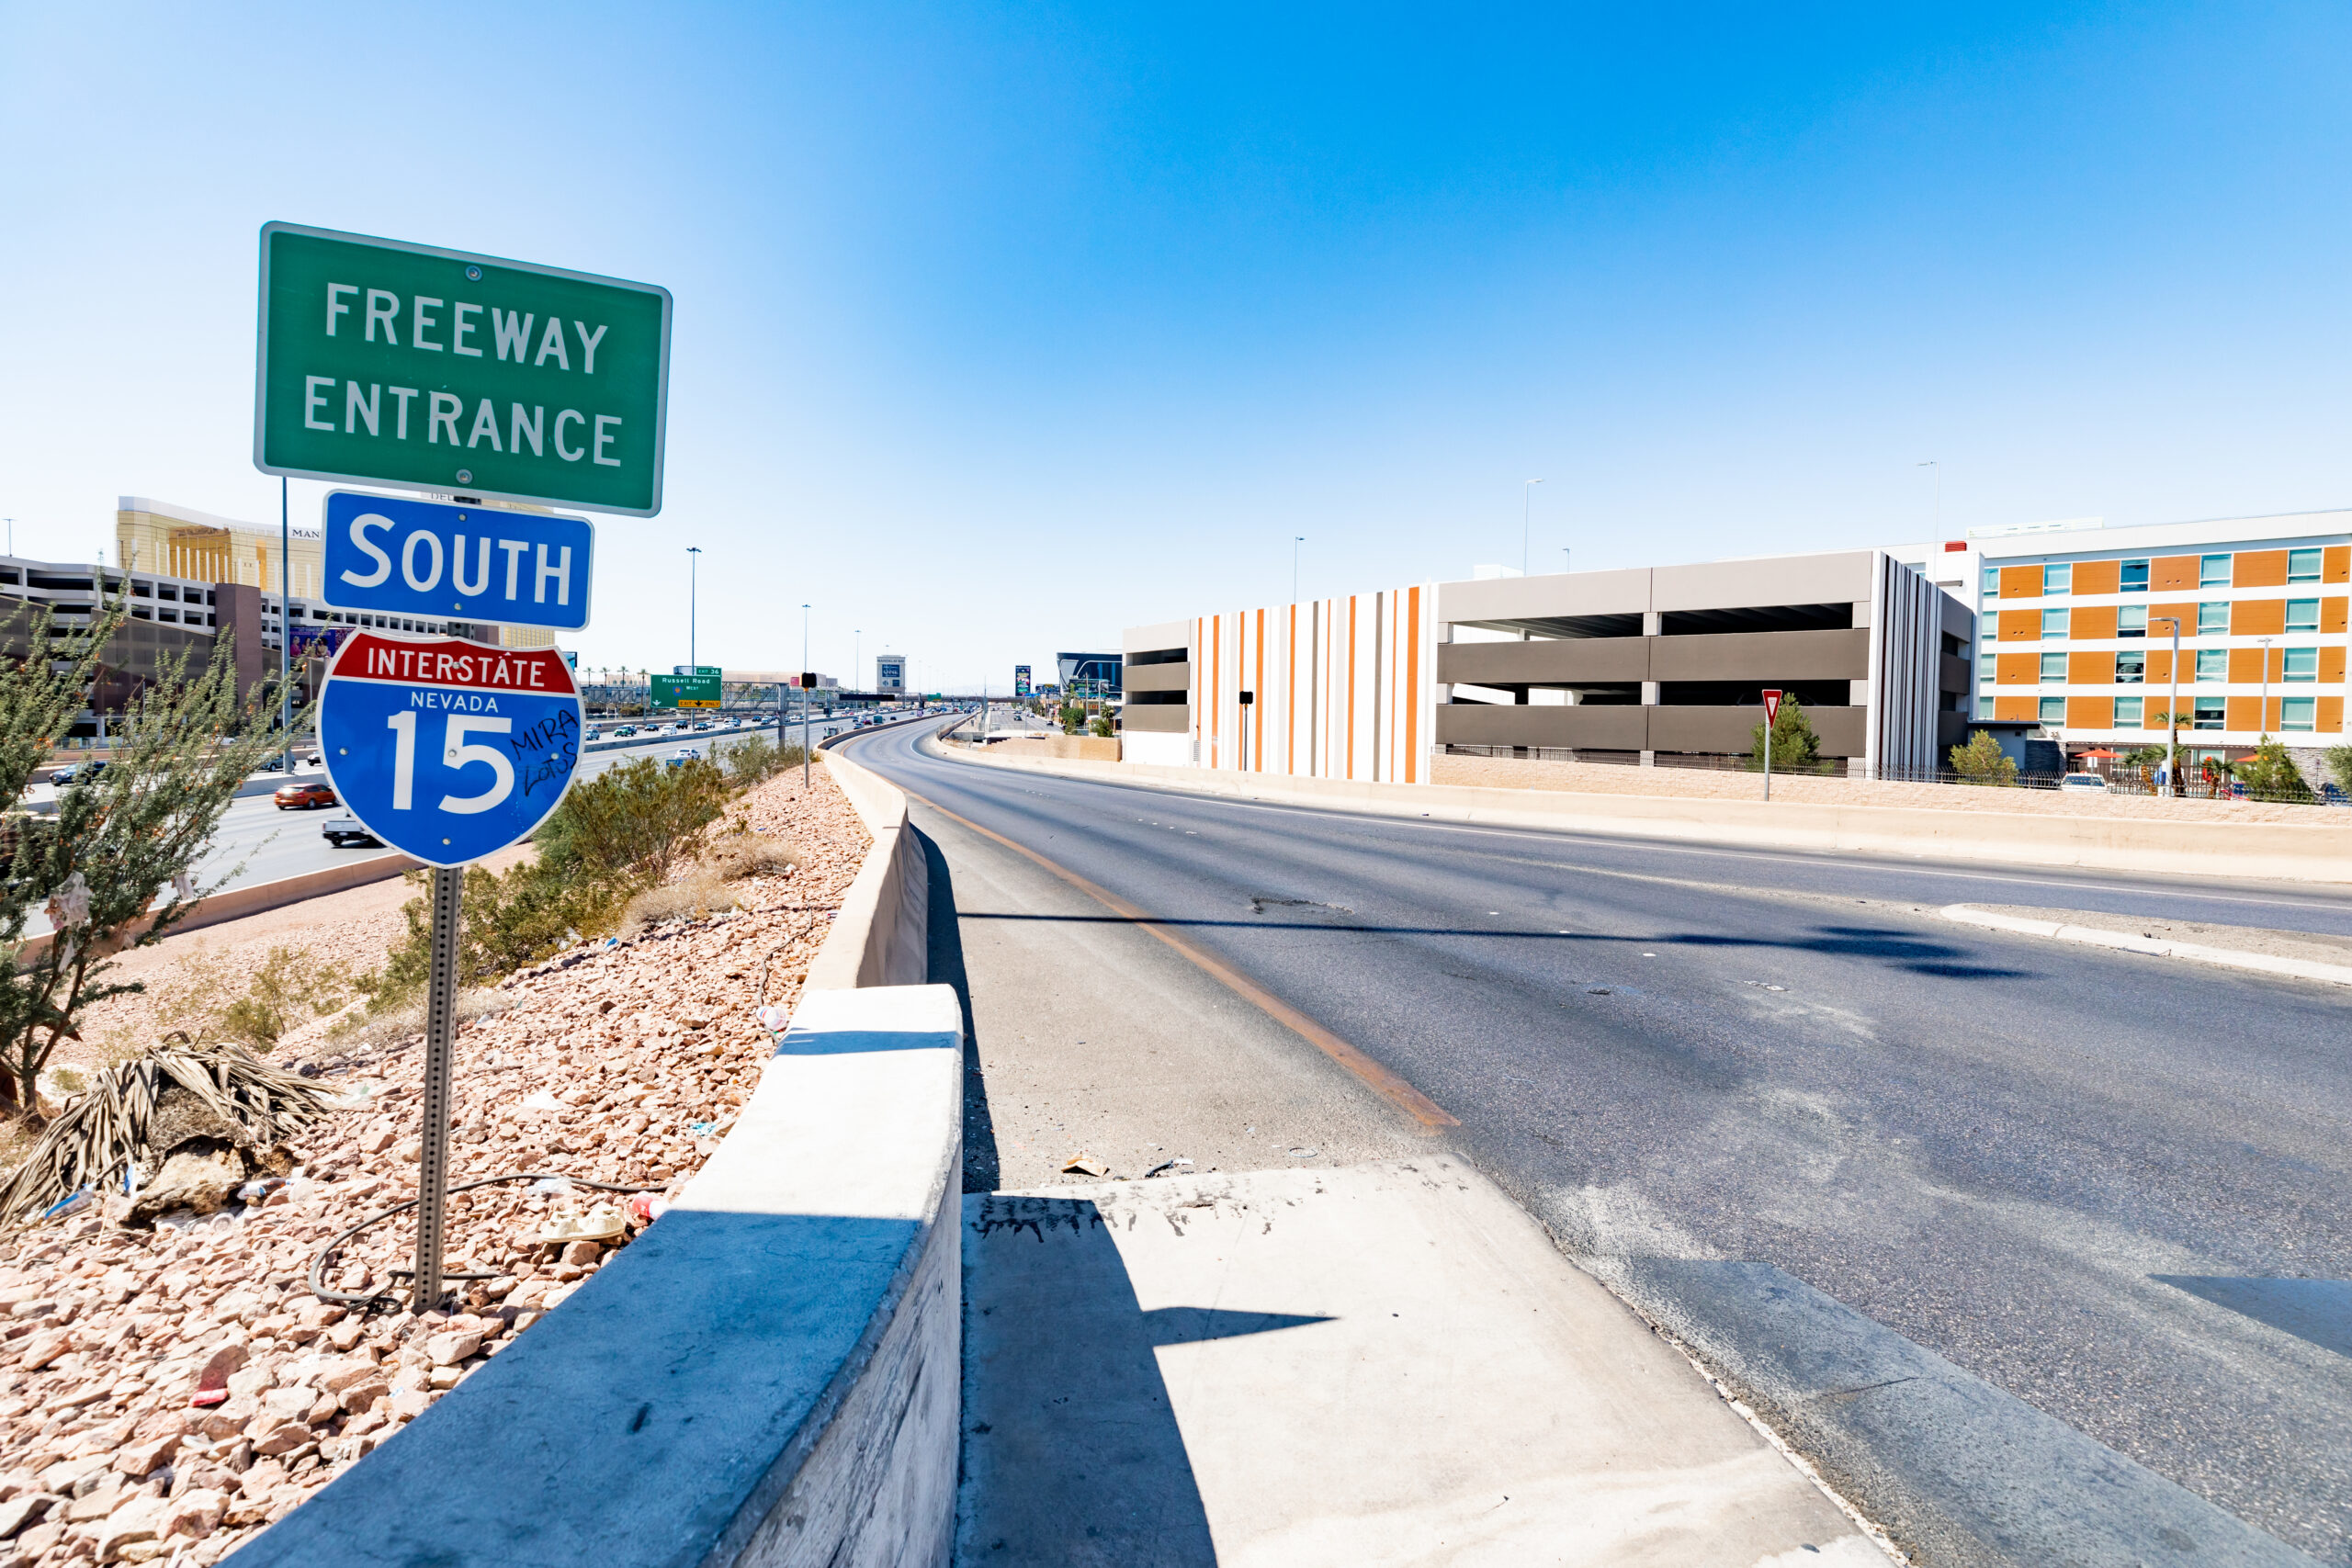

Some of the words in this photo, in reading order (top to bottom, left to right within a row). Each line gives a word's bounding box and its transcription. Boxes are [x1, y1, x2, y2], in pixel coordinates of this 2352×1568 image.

[326, 282, 608, 375] FREEWAY
[304, 375, 623, 468] ENTRANCE
[340, 513, 571, 606] SOUTH
[368, 648, 546, 687] INTERSTATE
[411, 691, 499, 713] NEVADA
[388, 710, 515, 815] 15
[510, 709, 579, 761] MIRA
